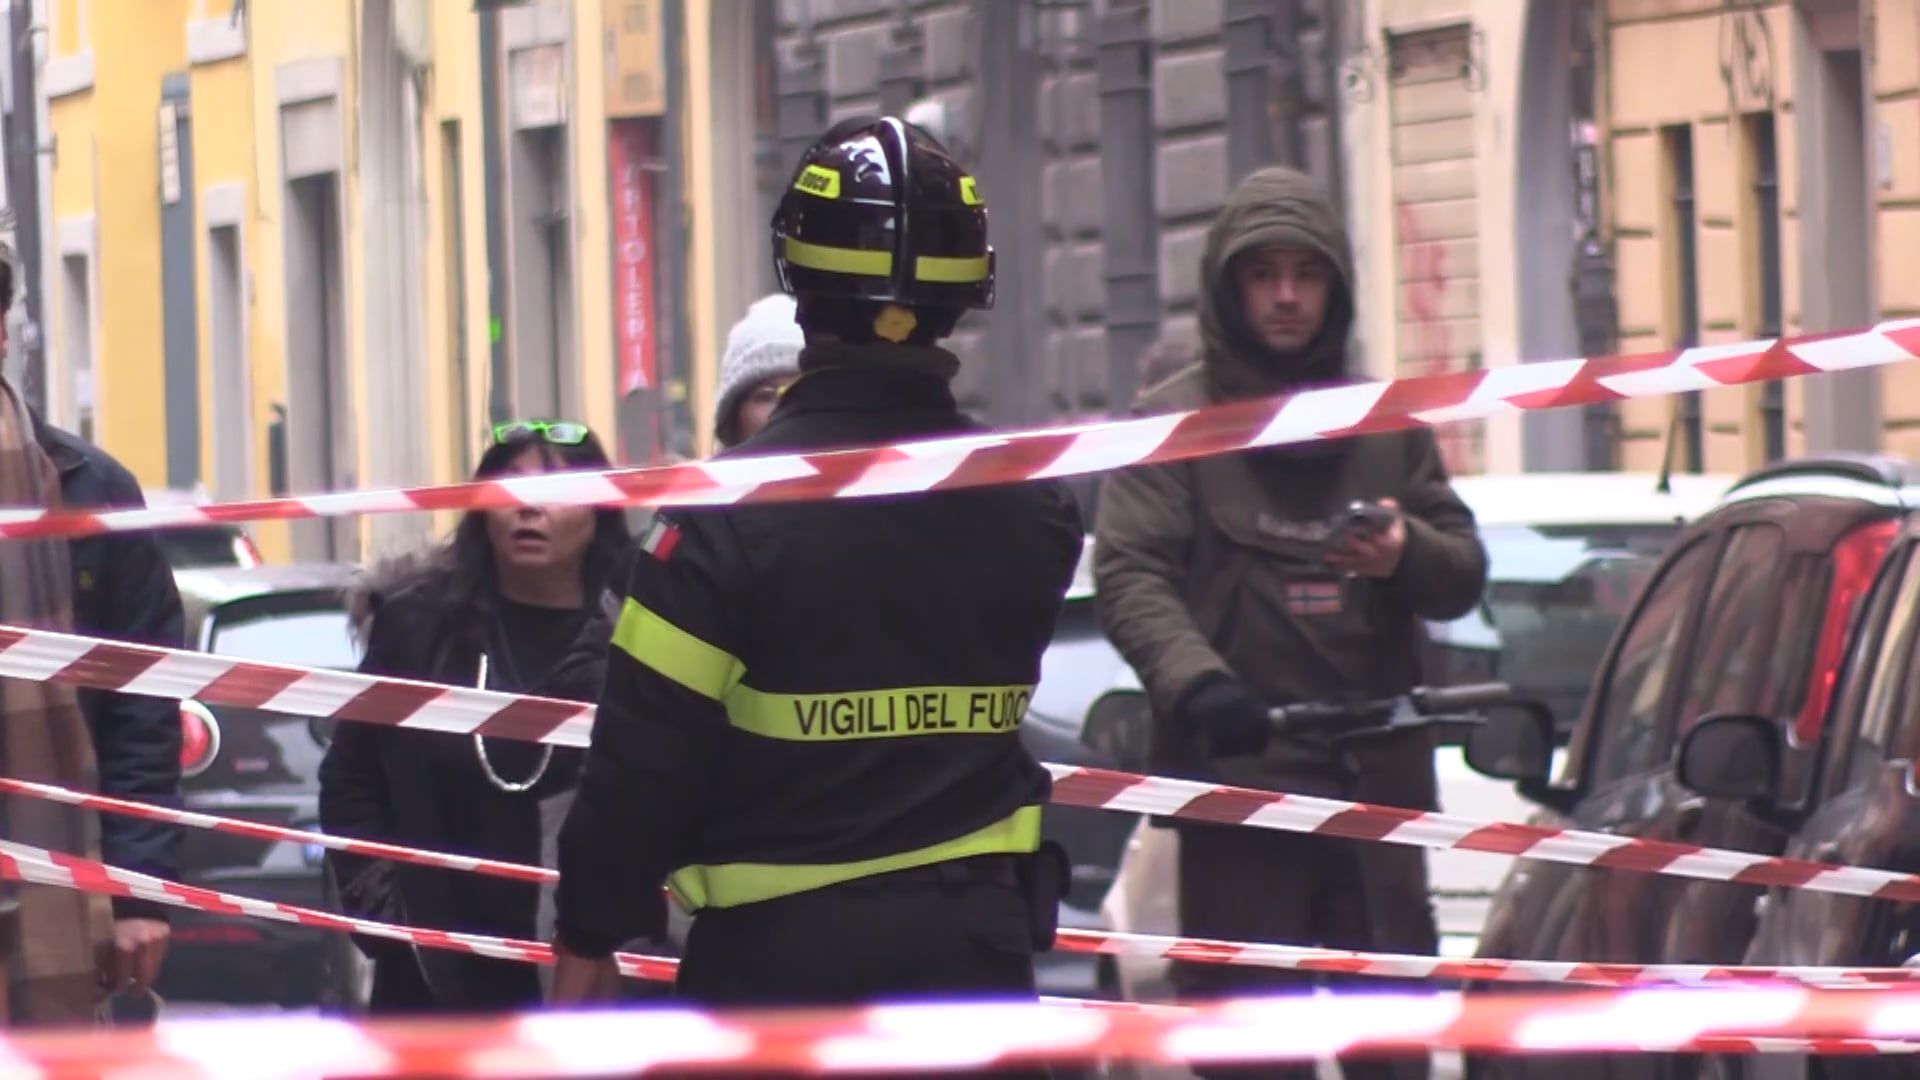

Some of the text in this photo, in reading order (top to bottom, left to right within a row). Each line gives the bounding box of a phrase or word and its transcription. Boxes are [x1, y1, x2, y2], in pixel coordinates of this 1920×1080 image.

[620, 135, 649, 389] ARTOLERIA
[793, 695, 896, 736] VIGILI
[905, 692, 957, 731] DEL
